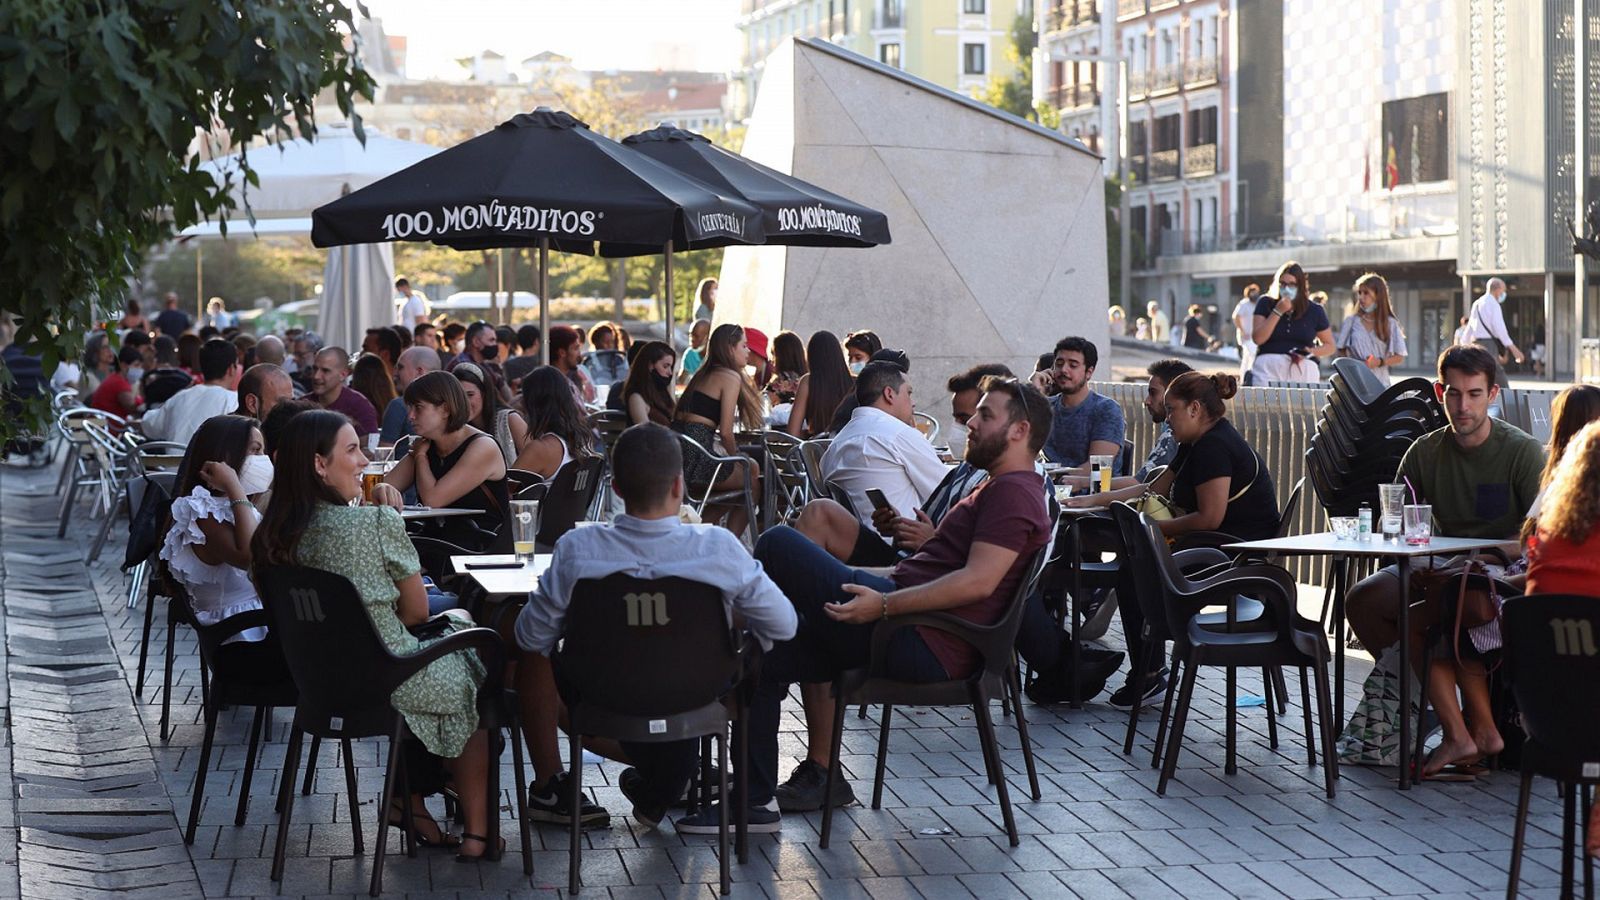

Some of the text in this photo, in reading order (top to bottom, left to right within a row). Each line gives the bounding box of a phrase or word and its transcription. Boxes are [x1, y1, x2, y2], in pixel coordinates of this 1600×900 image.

[381, 199, 595, 239] 100 MONTADITOS
[778, 203, 861, 236] 100 MONTADITOS
